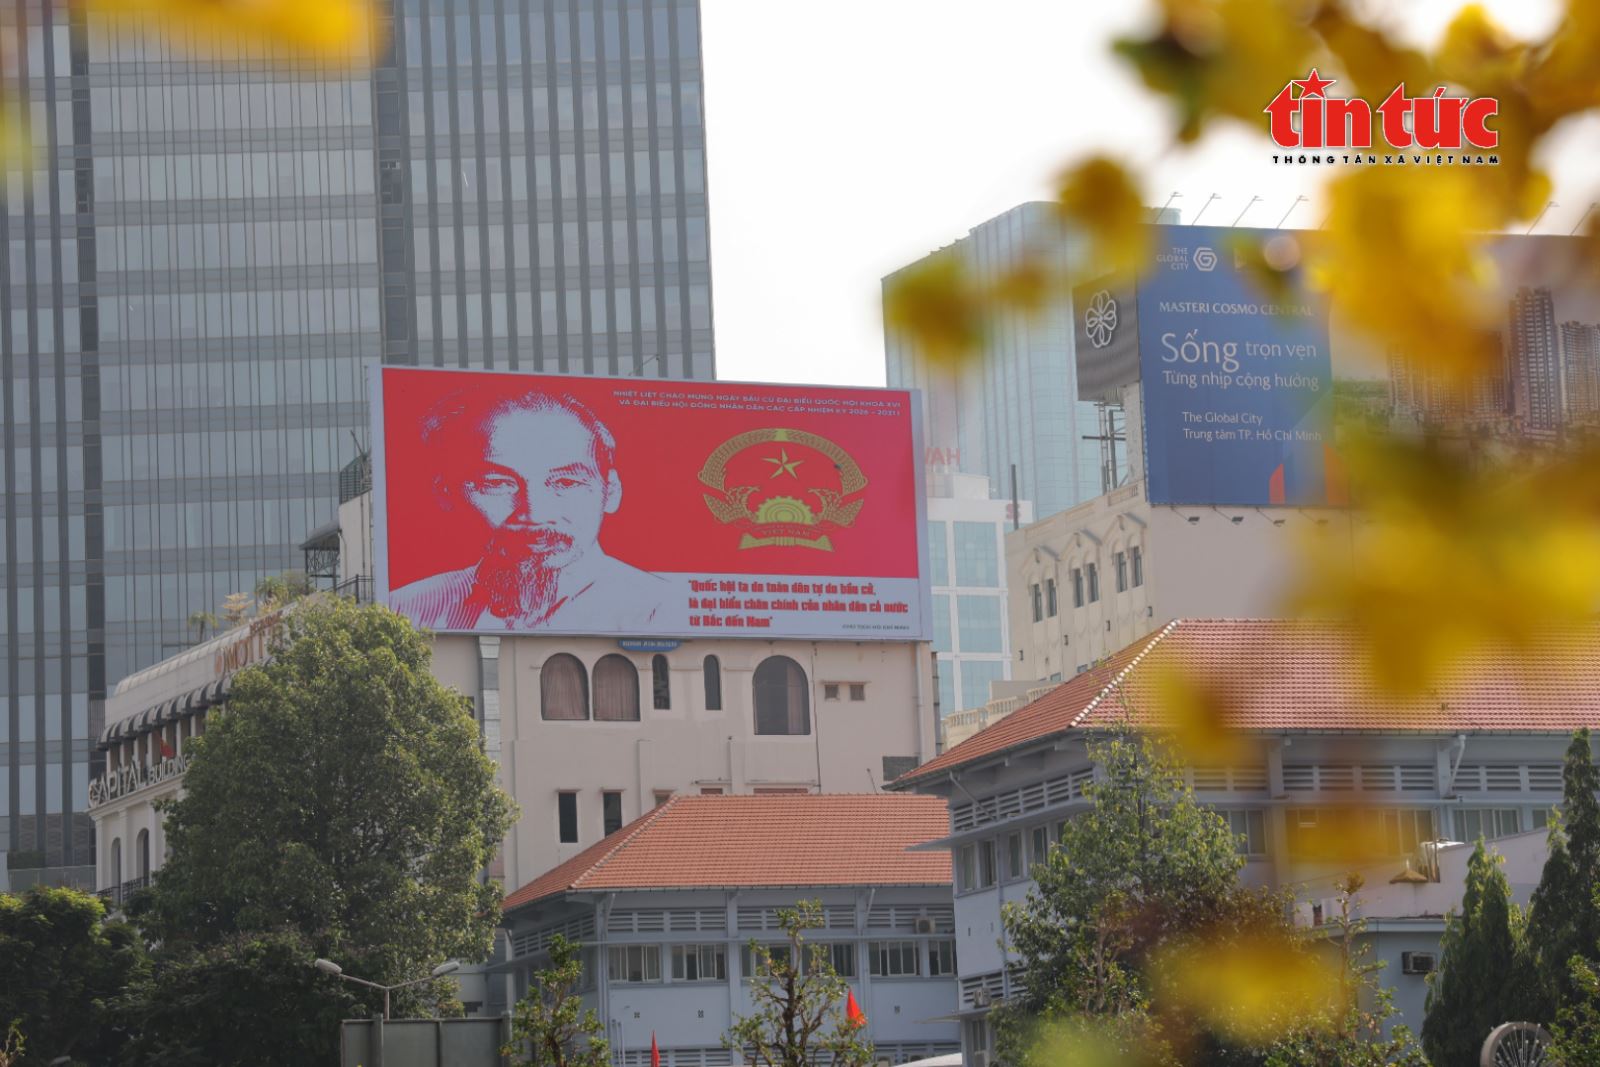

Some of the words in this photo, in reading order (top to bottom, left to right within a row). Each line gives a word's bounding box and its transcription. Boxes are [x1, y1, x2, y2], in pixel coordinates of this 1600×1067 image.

[1172, 247, 1188, 255] THE
[1156, 254, 1188, 263] GLOBAL
[1170, 262, 1188, 271] CITY
[1159, 301, 1210, 314] MASTERI
[1213, 303, 1258, 316] COSMO
[1161, 329, 1240, 373] Sống
[1245, 341, 1282, 361] trọn
[1285, 343, 1317, 361] vẹn
[1162, 370, 1198, 389] Từng
[1202, 373, 1232, 391] nhịp
[1236, 373, 1271, 390] cộng
[1274, 373, 1319, 391] hưởng
[1182, 412, 1202, 423] The
[1205, 412, 1239, 424] Global
[1241, 412, 1263, 426] City
[1183, 429, 1213, 441] Trung
[1216, 429, 1236, 440] tâm
[1256, 428, 1272, 441] Hồ
[1275, 429, 1292, 441] Chí
[1295, 430, 1322, 441] Minh
[738, 581, 749, 592] ta
[751, 581, 764, 593] do
[791, 581, 810, 594] dân
[825, 582, 838, 594] do
[89, 760, 146, 808] CAPITAL
